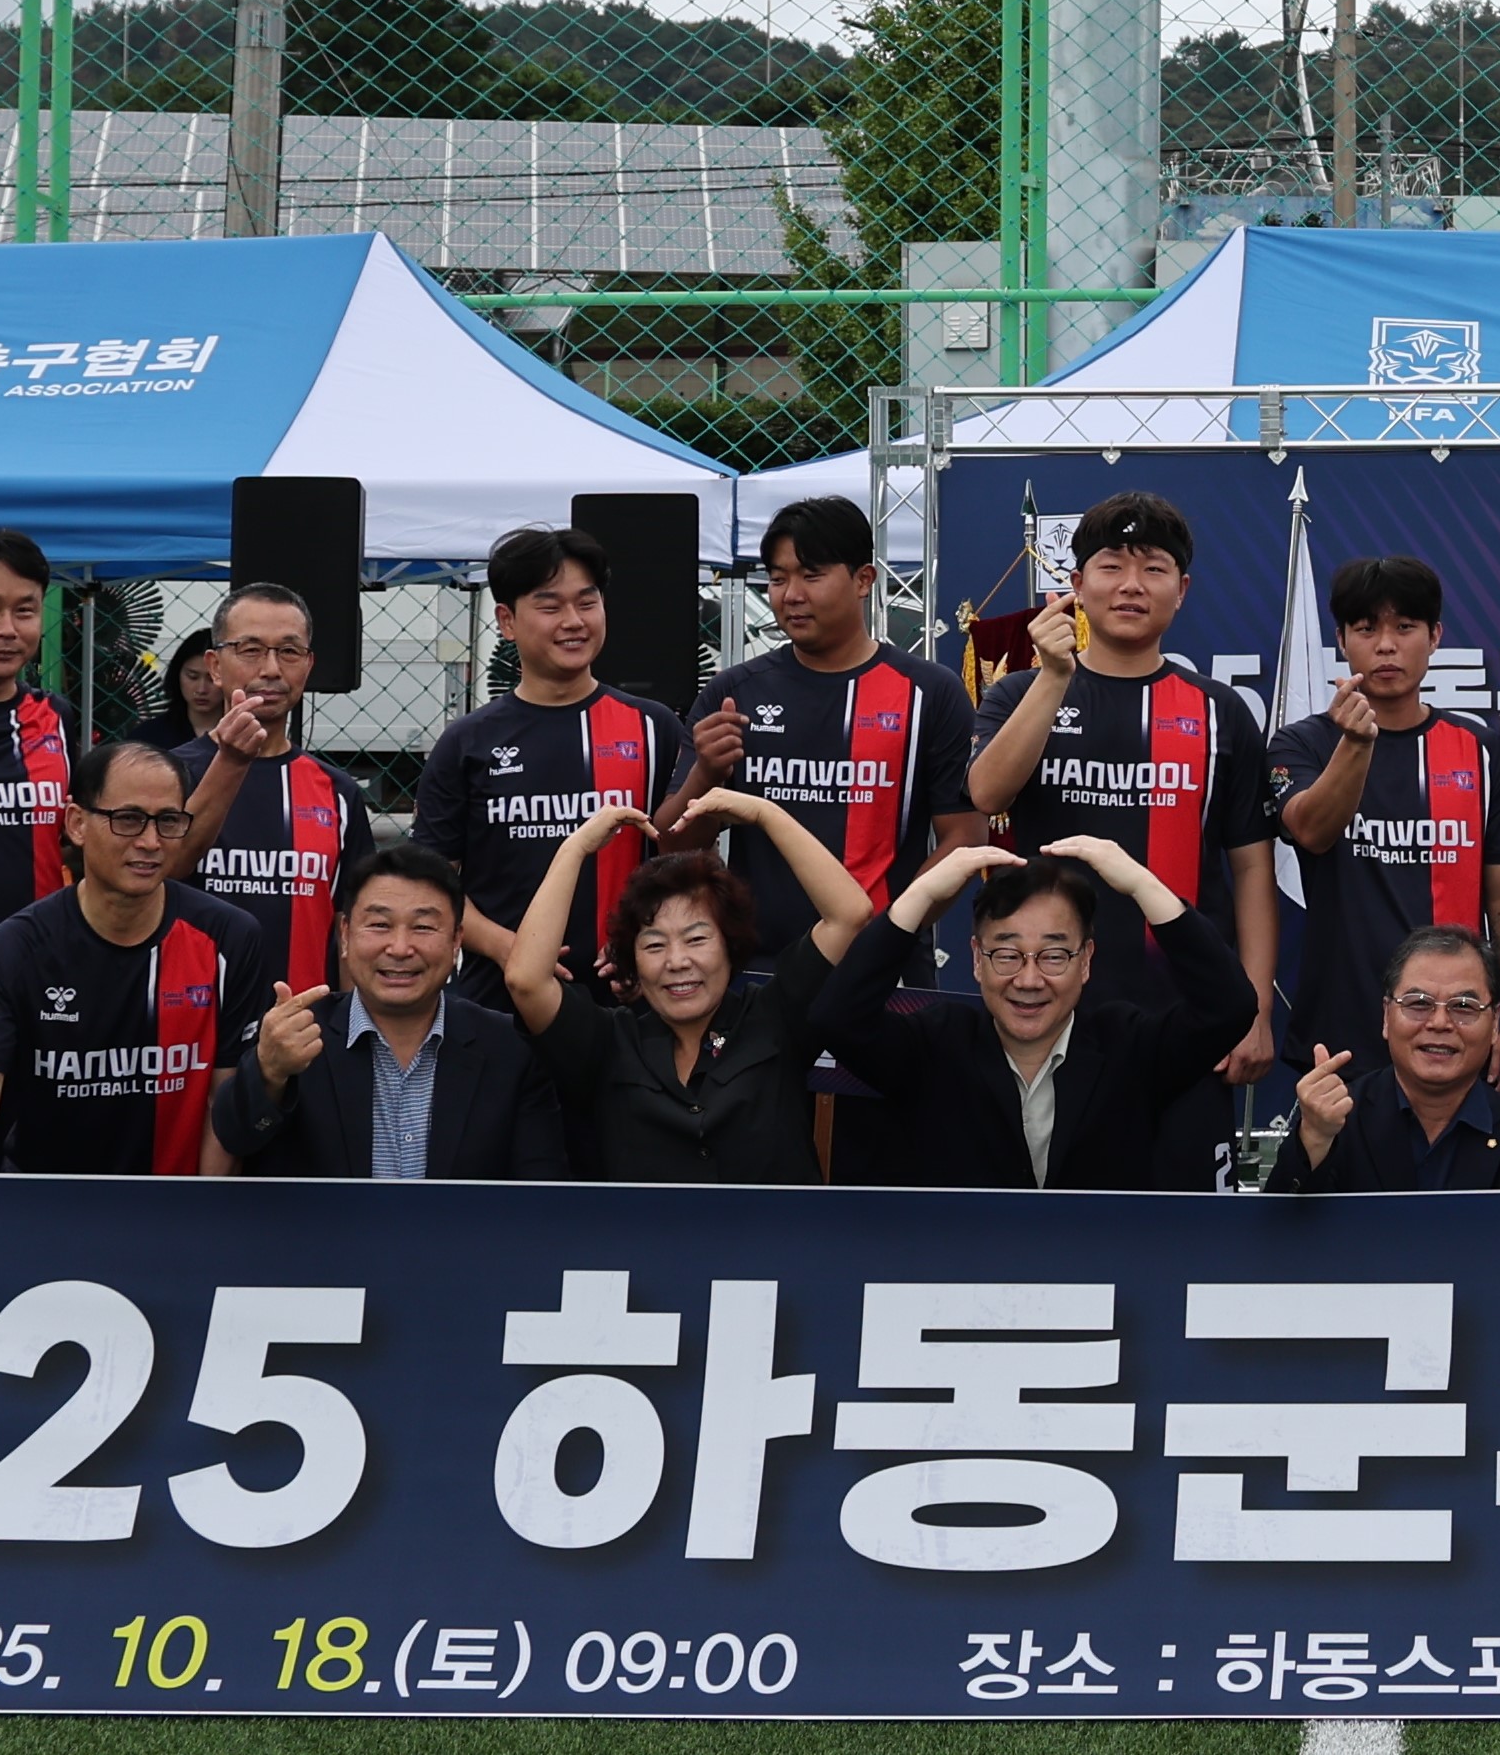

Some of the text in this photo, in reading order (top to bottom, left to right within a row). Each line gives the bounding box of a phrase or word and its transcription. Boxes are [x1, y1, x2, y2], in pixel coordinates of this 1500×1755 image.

[3, 378, 195, 398] ASSOCIATION
[750, 723, 785, 734] hummel
[488, 763, 524, 776] hummel
[745, 756, 895, 788] HANWOOL
[1041, 758, 1199, 791] HANWOOL
[764, 786, 873, 803] FOOTBALL CLUB
[1062, 789, 1176, 807] FOOTBALL CLUB
[22, 810, 56, 826] CLUB
[1345, 812, 1475, 847] ANWOOL
[1420, 849, 1457, 864] CLUB
[205, 877, 315, 897] FOOTBALL CLUB
[40, 1010, 80, 1022] hummel
[34, 1042, 210, 1081] HANWOOL
[56, 1077, 185, 1099] FOOTBALL CLUB
[113, 1615, 222, 1692] 10.
[566, 1631, 798, 1694] 09:00
[958, 1629, 1119, 1700] 장소
